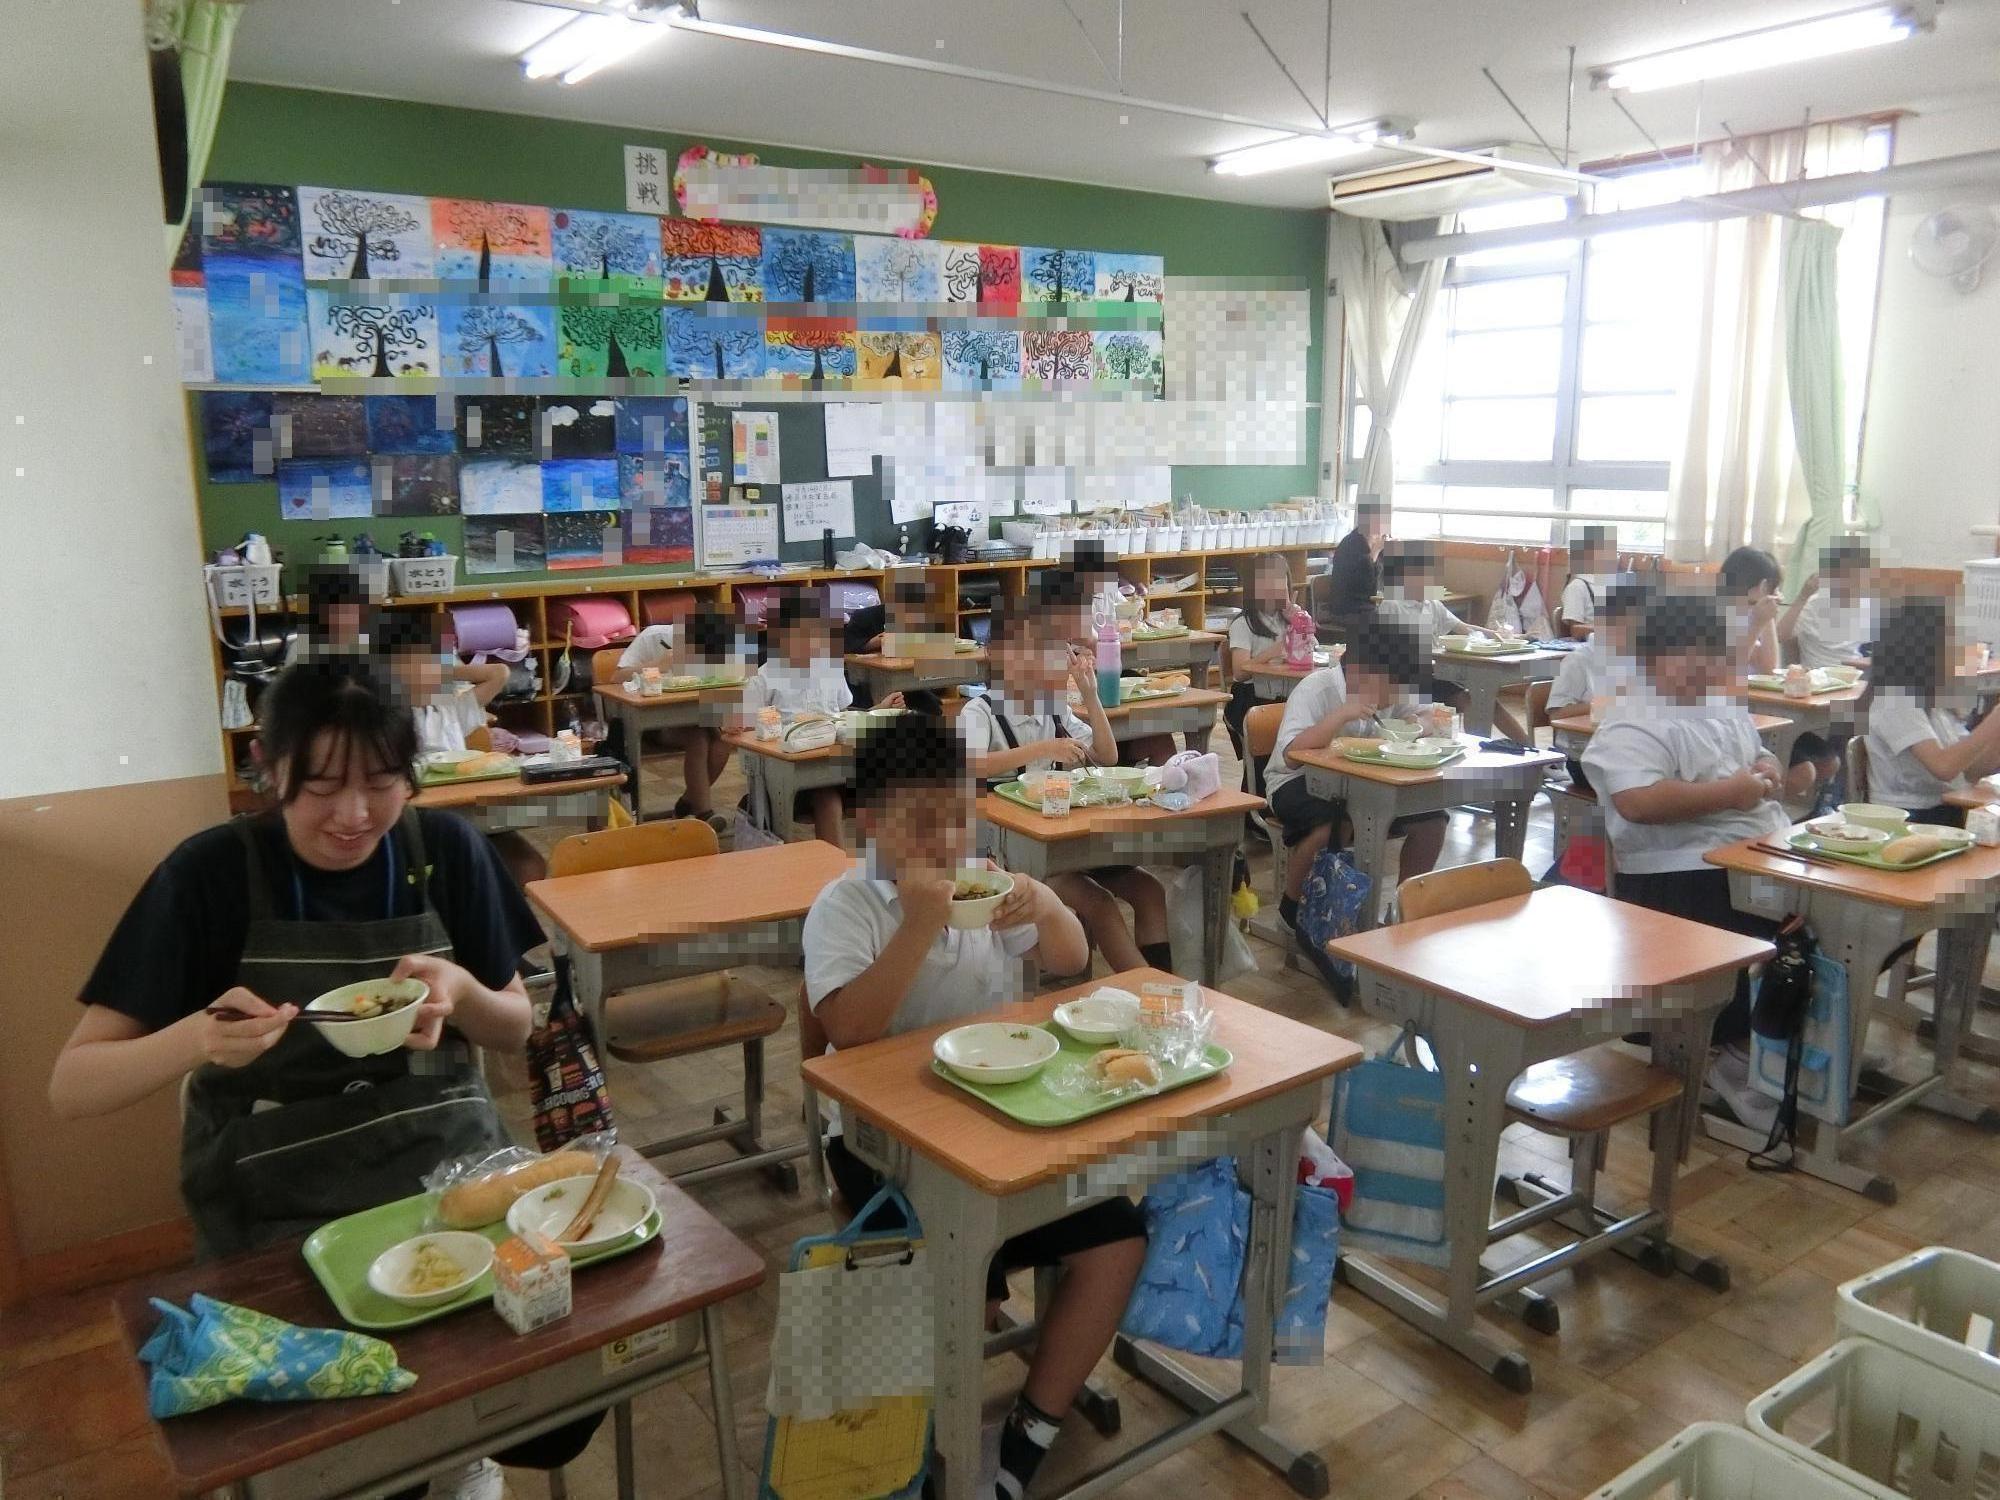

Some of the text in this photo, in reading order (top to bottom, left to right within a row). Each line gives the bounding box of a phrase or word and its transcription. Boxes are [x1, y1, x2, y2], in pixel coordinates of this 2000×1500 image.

[634, 152, 660, 206] 挑戦
[407, 568, 445, 578] 水とう
